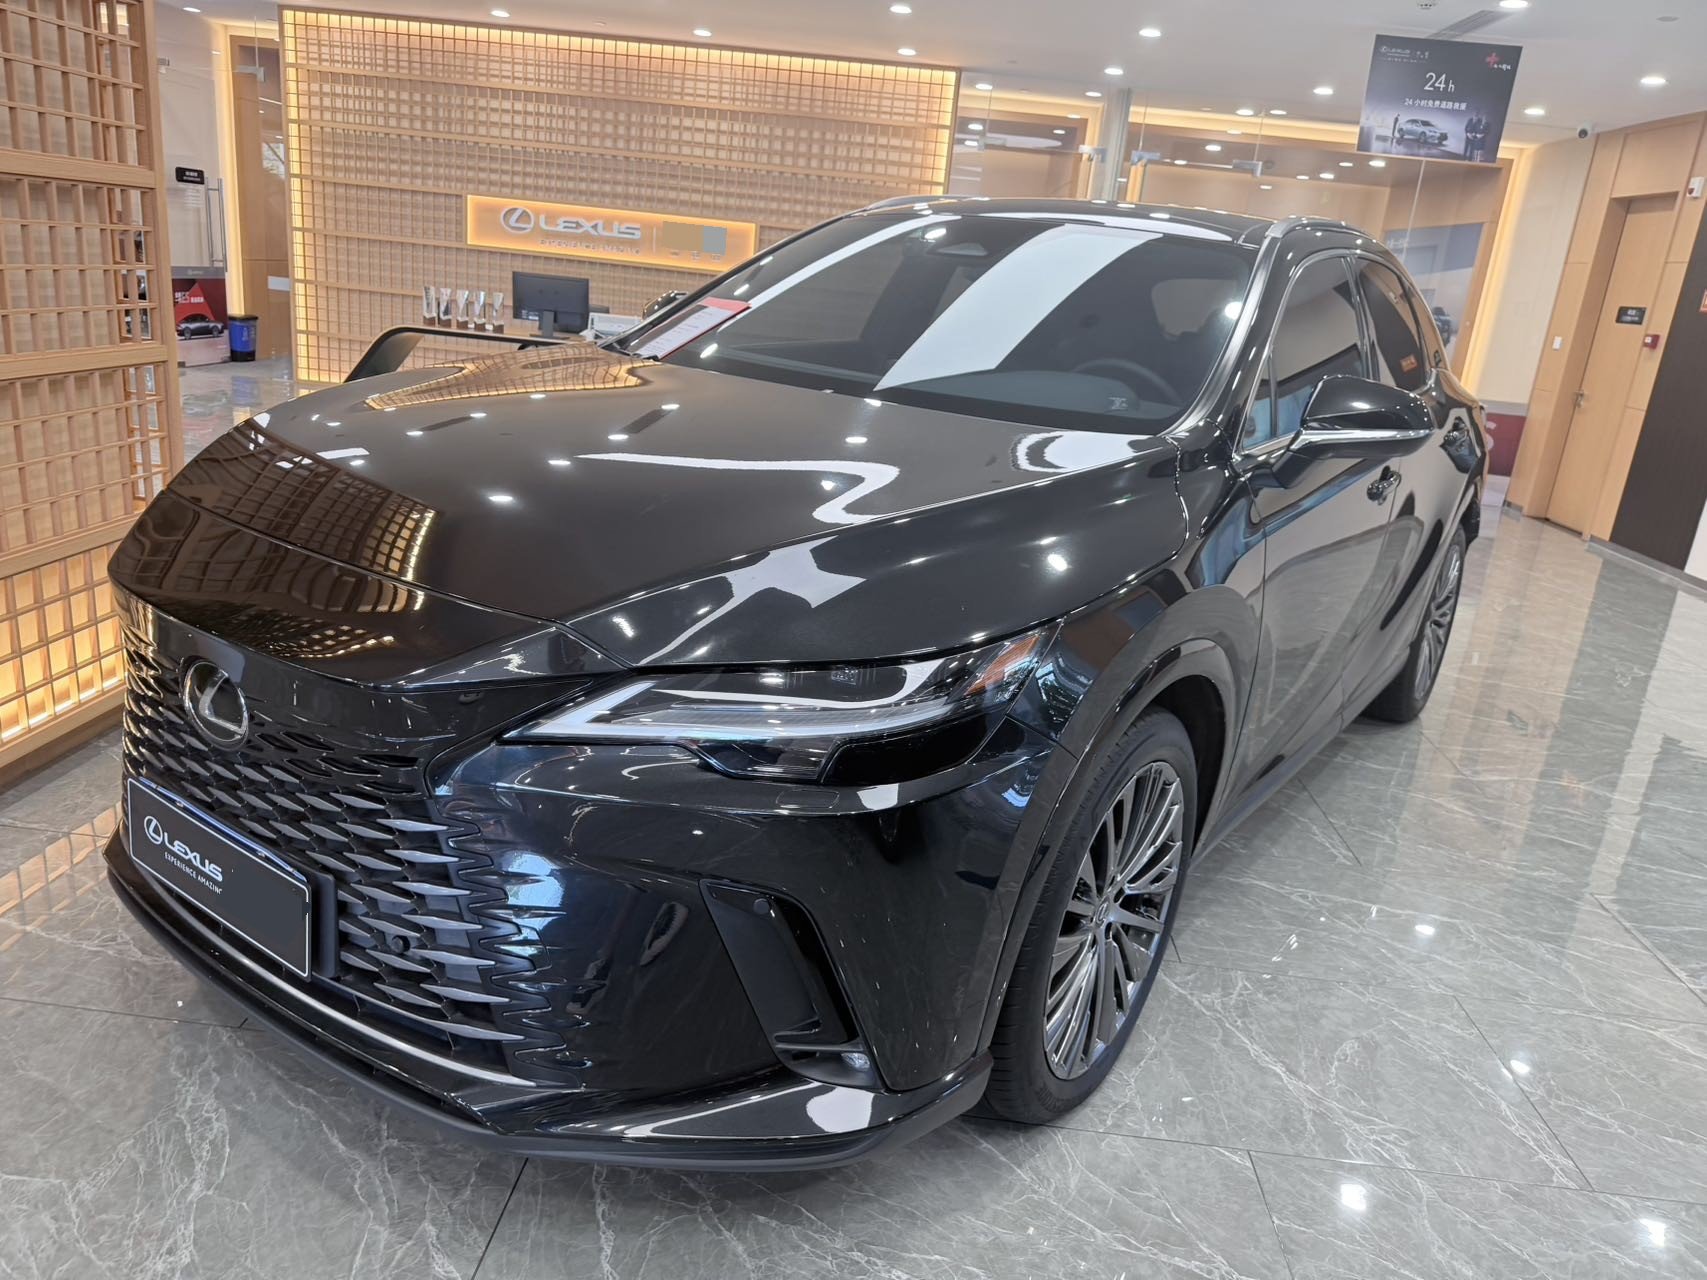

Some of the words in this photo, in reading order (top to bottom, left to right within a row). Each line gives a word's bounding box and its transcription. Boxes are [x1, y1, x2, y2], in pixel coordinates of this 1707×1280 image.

[1423, 71, 1446, 91] 24
[1447, 79, 1455, 93] h
[539, 213, 641, 240] LEXUS
[164, 832, 223, 882] LEXUS
[164, 851, 197, 879] EXPERIENCE
